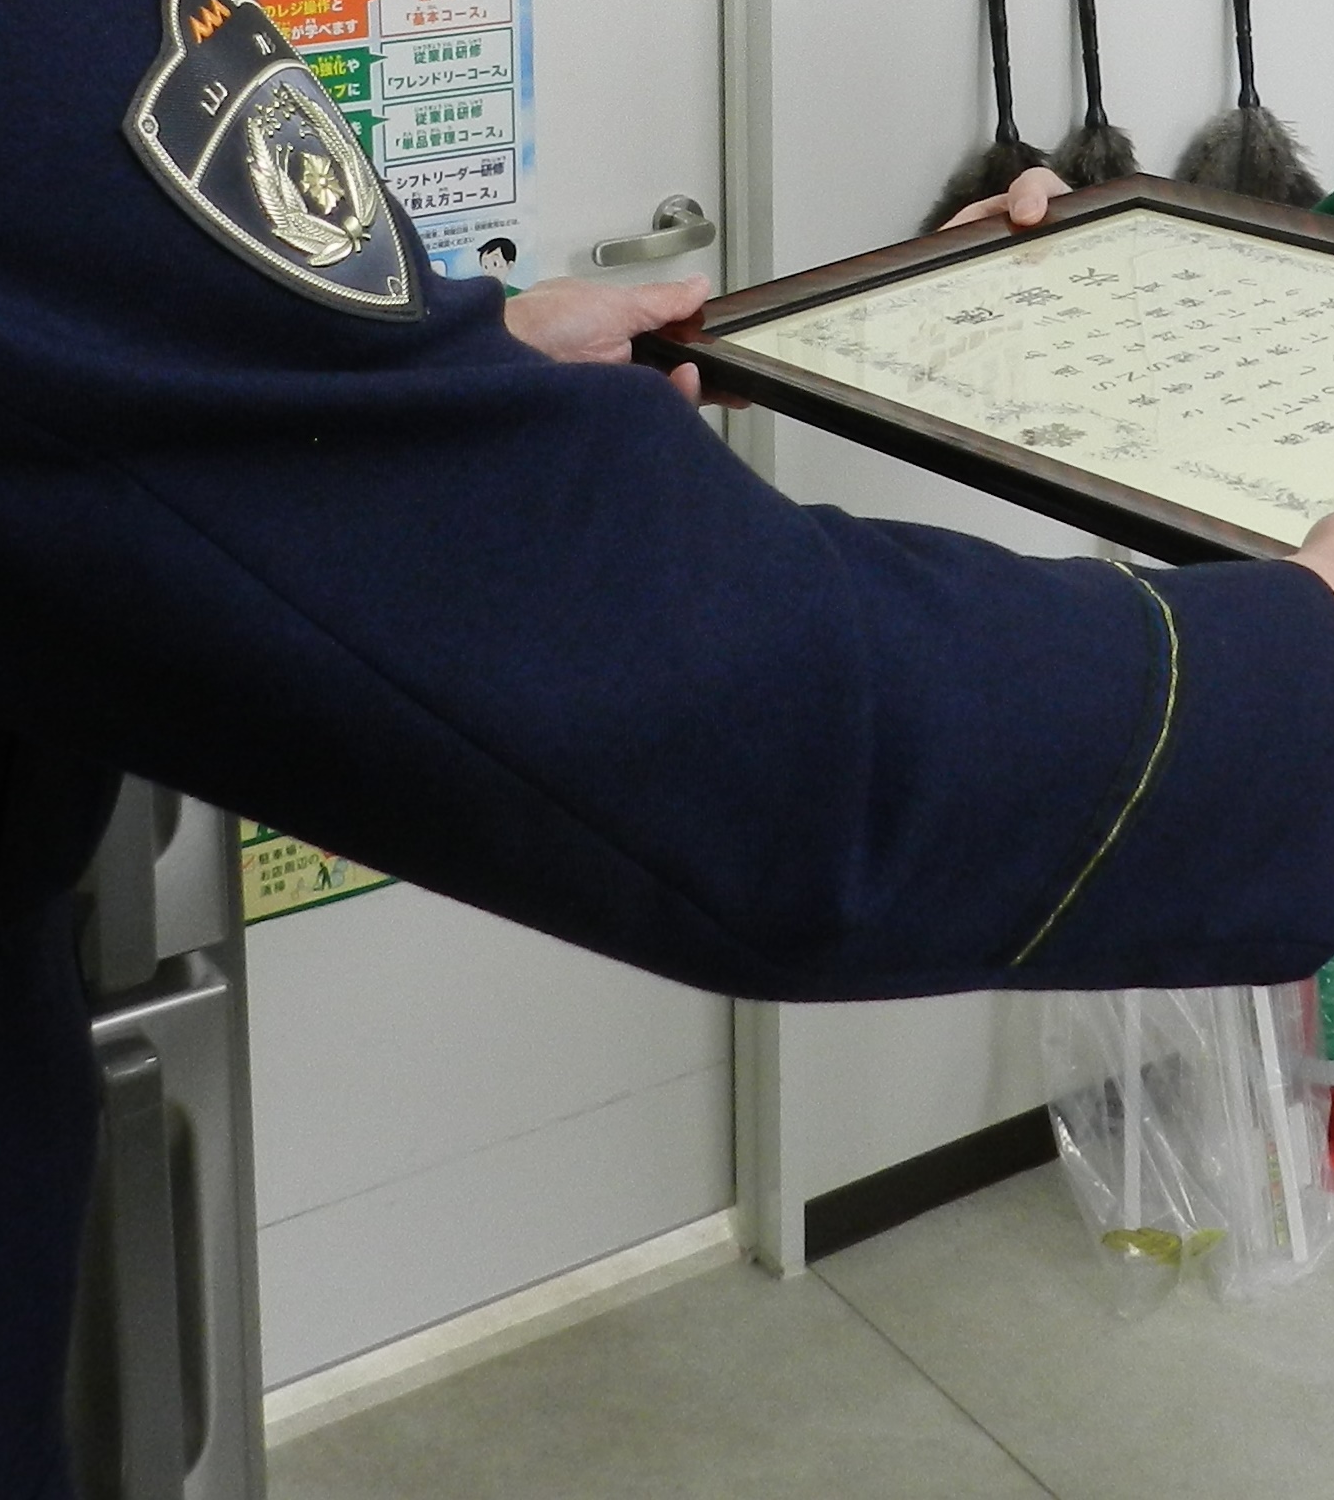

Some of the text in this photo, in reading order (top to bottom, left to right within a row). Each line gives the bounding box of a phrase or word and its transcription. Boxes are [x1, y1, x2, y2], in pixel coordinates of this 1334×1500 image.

[406, 6, 487, 26] 「基本コース」
[414, 44, 482, 64] 従業員研修
[388, 65, 507, 90] 「フレンドリーコース」
[415, 104, 483, 126] 従業員研修
[396, 126, 503, 150] 「単品管理コース」
[396, 162, 505, 190] シフトリーダー研修
[943, 265, 1121, 326] 感謝状
